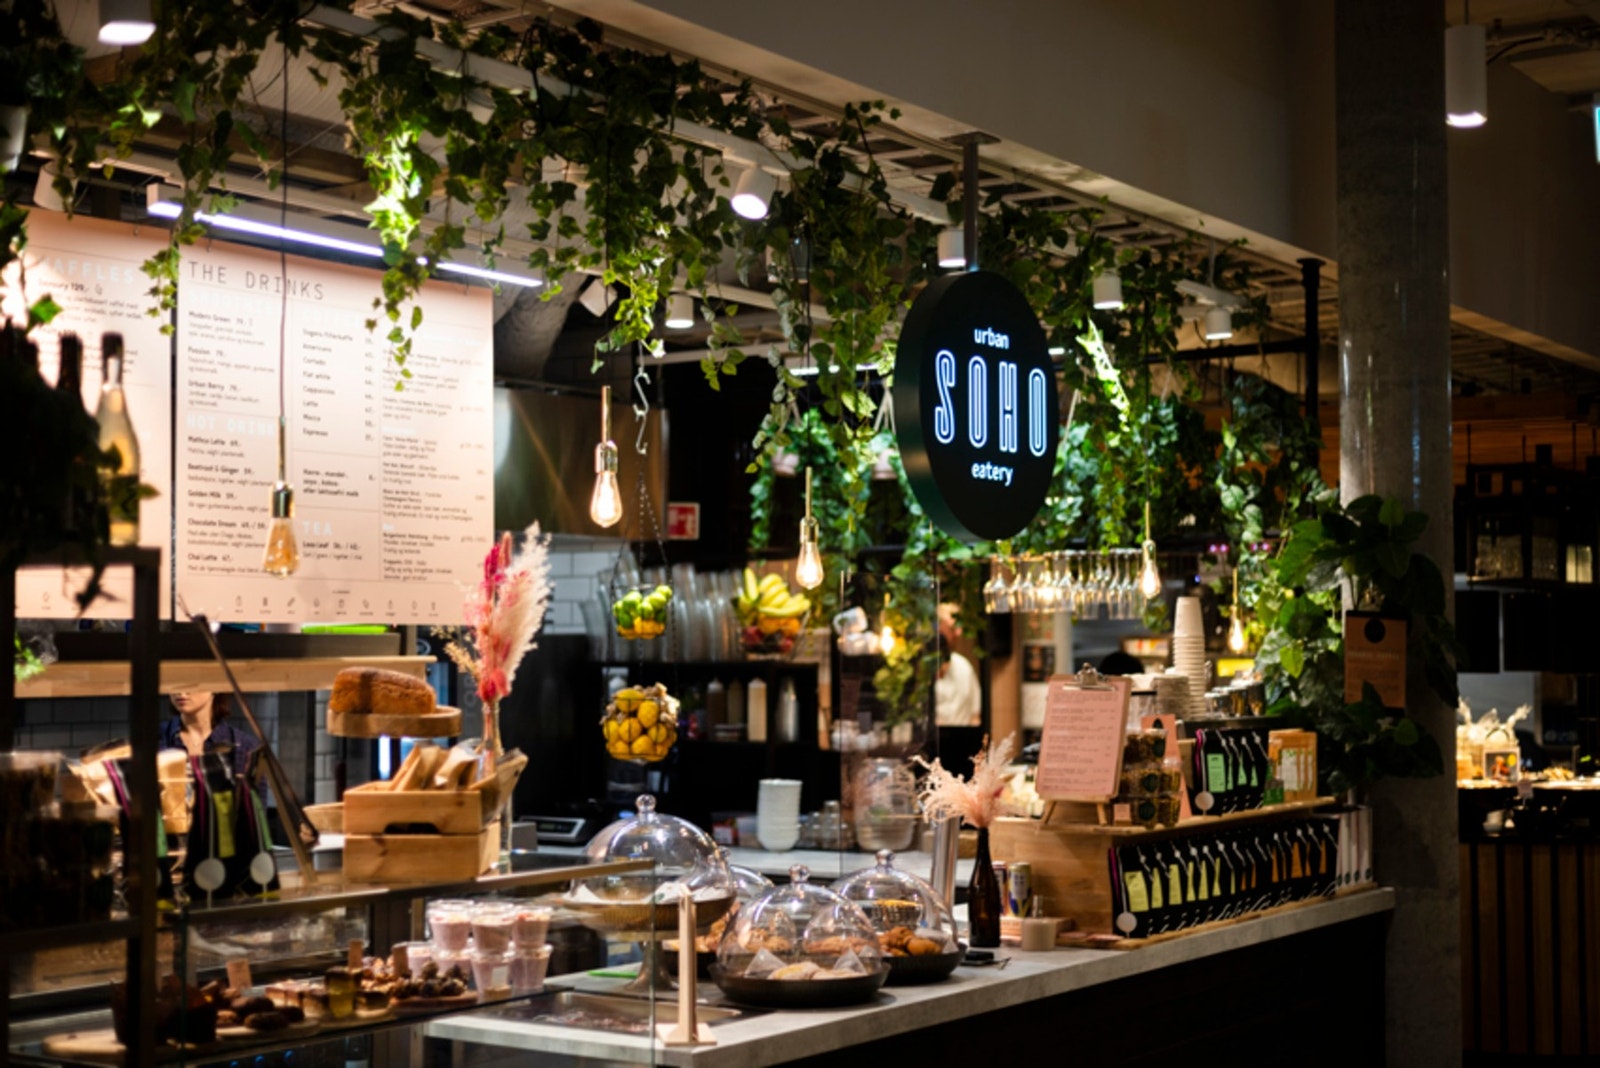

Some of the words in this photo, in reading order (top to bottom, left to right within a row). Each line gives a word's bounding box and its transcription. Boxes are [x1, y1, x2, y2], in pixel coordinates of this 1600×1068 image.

[188, 260, 227, 285] THE
[245, 270, 324, 300] DRINKS
[974, 327, 1010, 350] urban
[934, 348, 1047, 457] SOHO
[187, 414, 217, 431] HOT
[227, 419, 275, 437] DRINK
[971, 462, 1014, 487] eatery
[302, 520, 332, 537] TEA
